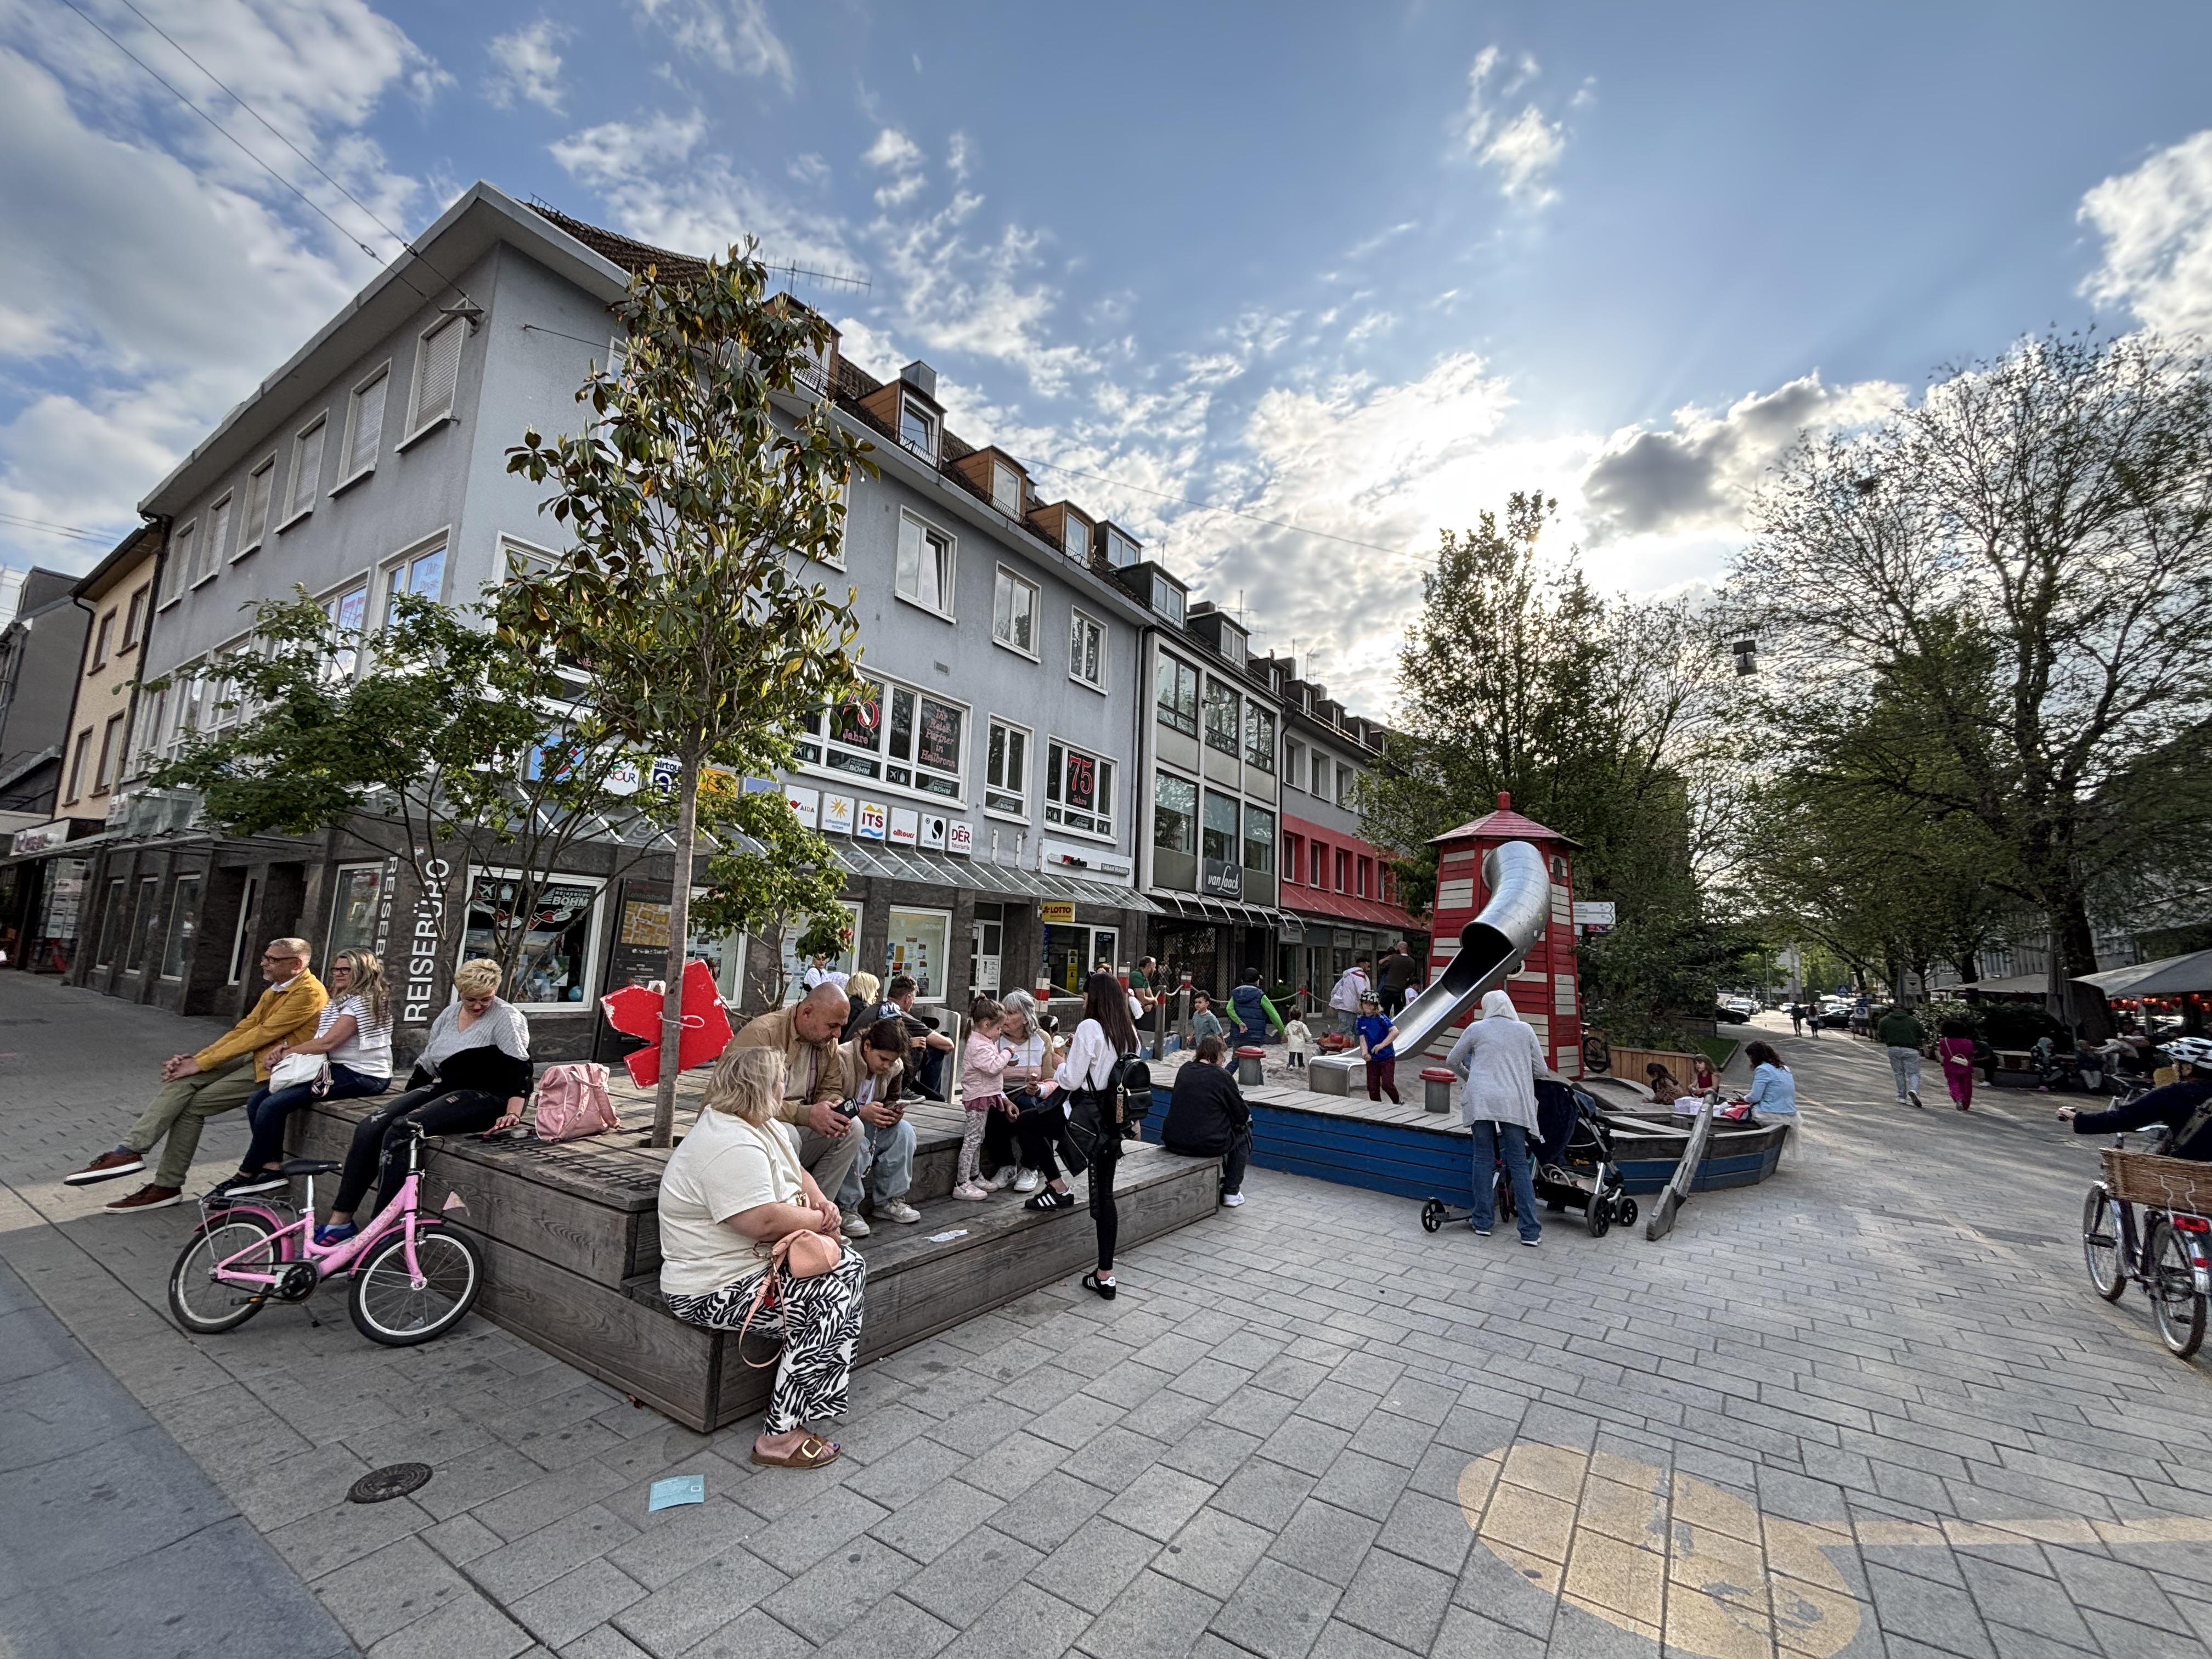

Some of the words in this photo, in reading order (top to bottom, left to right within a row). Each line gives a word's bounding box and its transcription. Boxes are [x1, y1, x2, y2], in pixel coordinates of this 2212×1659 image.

[843, 729, 868, 744] Jahre
[925, 728, 954, 745] Partner
[935, 742, 944, 753] in
[920, 749, 956, 768] Heilbronn
[654, 760, 682, 771] airtou
[849, 763, 870, 775] BÖHM
[1069, 754, 1093, 794] 75
[934, 785, 951, 795] BÖHM
[862, 812, 883, 828] ITS
[893, 828, 915, 839] alltours
[951, 828, 970, 844] DER
[951, 842, 970, 850] Touristik
[1207, 875, 1221, 887] van
[375, 856, 398, 956] REISEB
[551, 895, 589, 907] BÖHM
[403, 858, 450, 1022] REISEBÜRO
